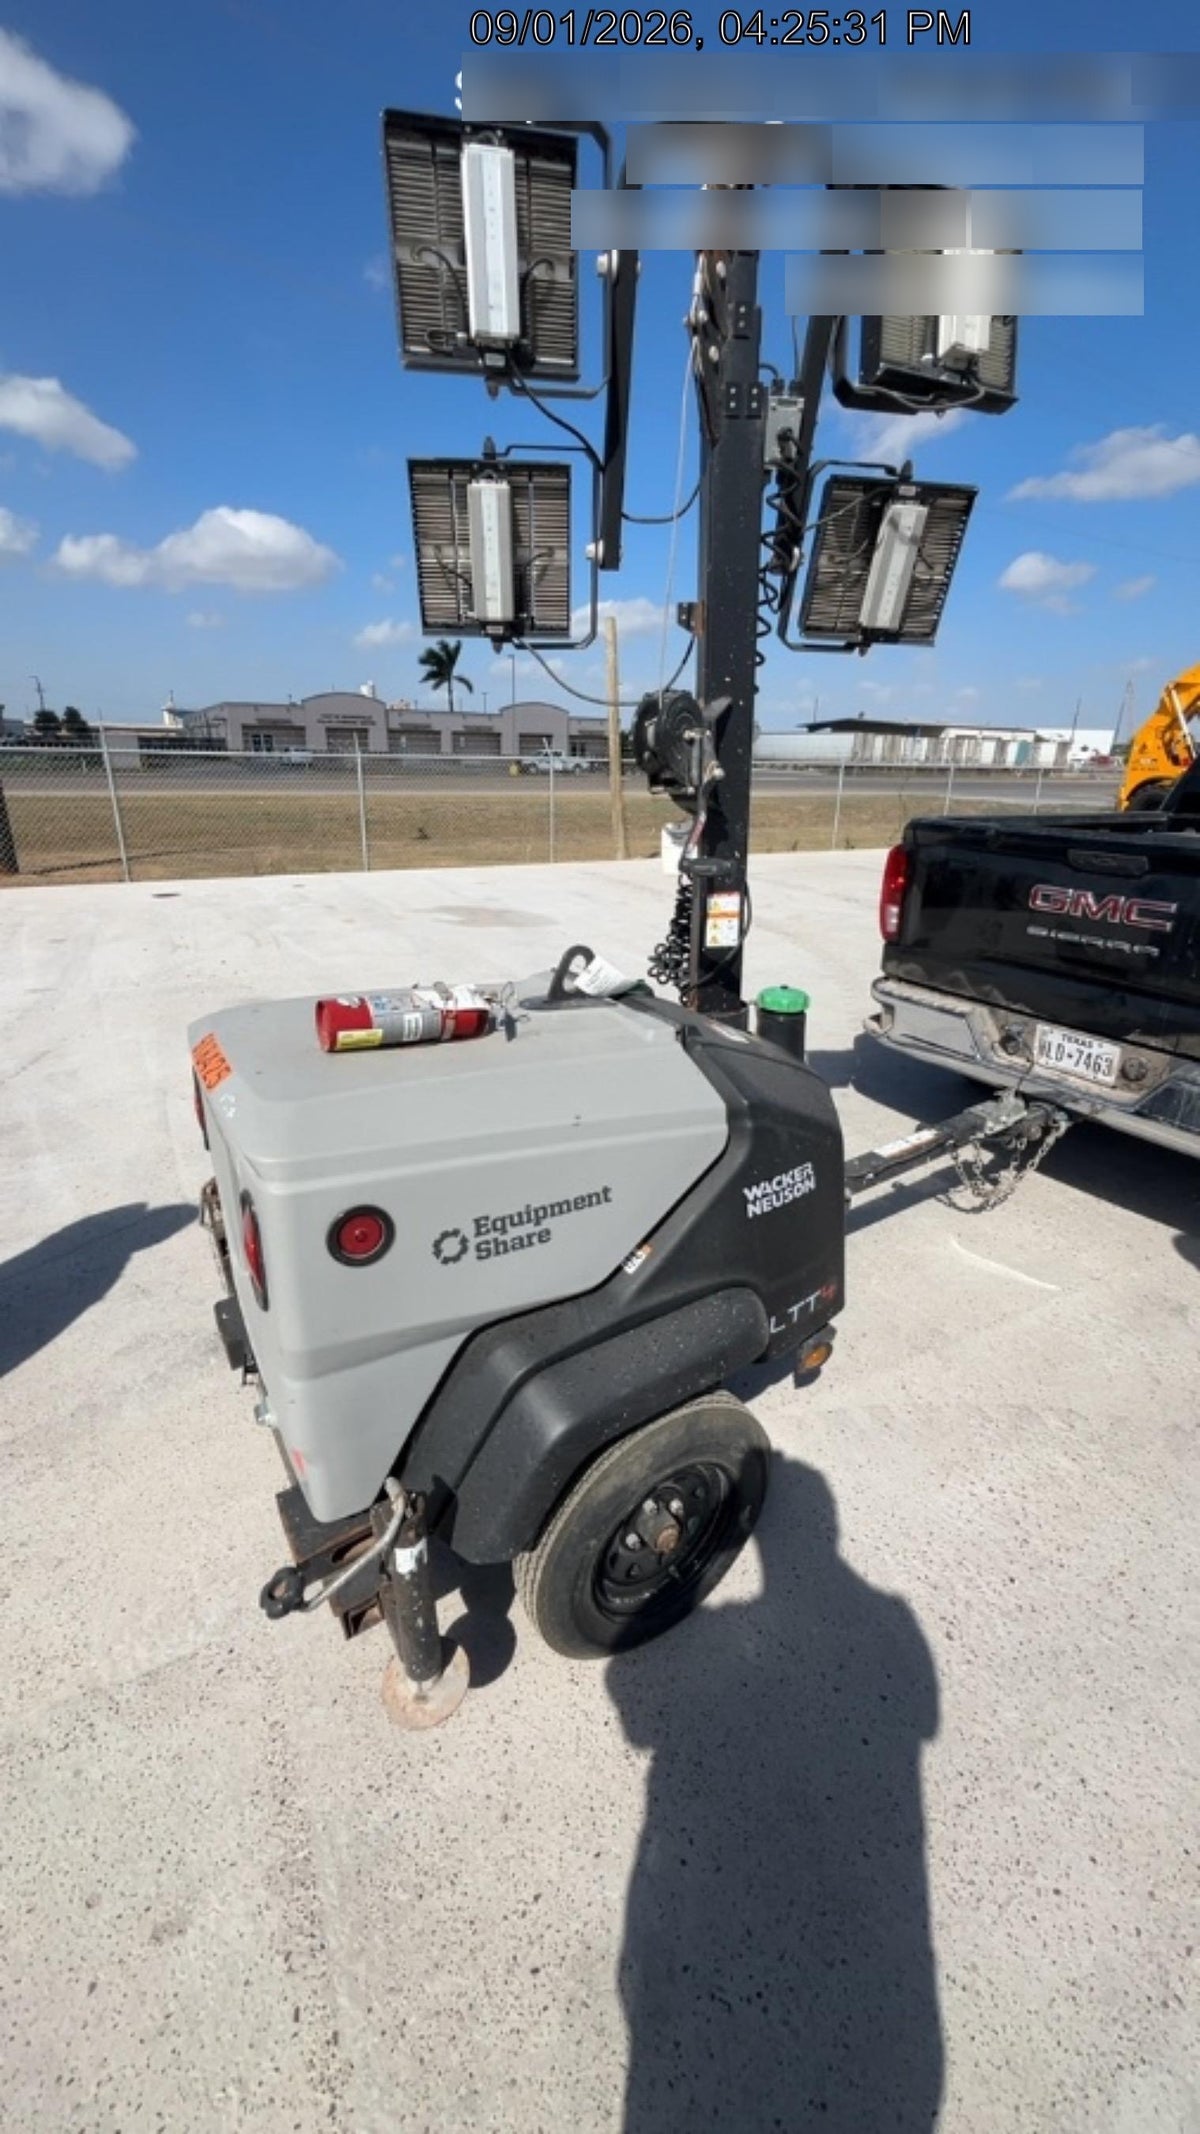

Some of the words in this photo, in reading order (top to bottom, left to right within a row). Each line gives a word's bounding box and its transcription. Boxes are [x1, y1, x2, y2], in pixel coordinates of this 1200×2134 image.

[1028, 884, 1178, 932] GMC
[743, 1162, 814, 1201] WACKER
[747, 1177, 816, 1218] NEUSON
[472, 1185, 613, 1239] Equipment
[475, 1226, 552, 1260] Share
